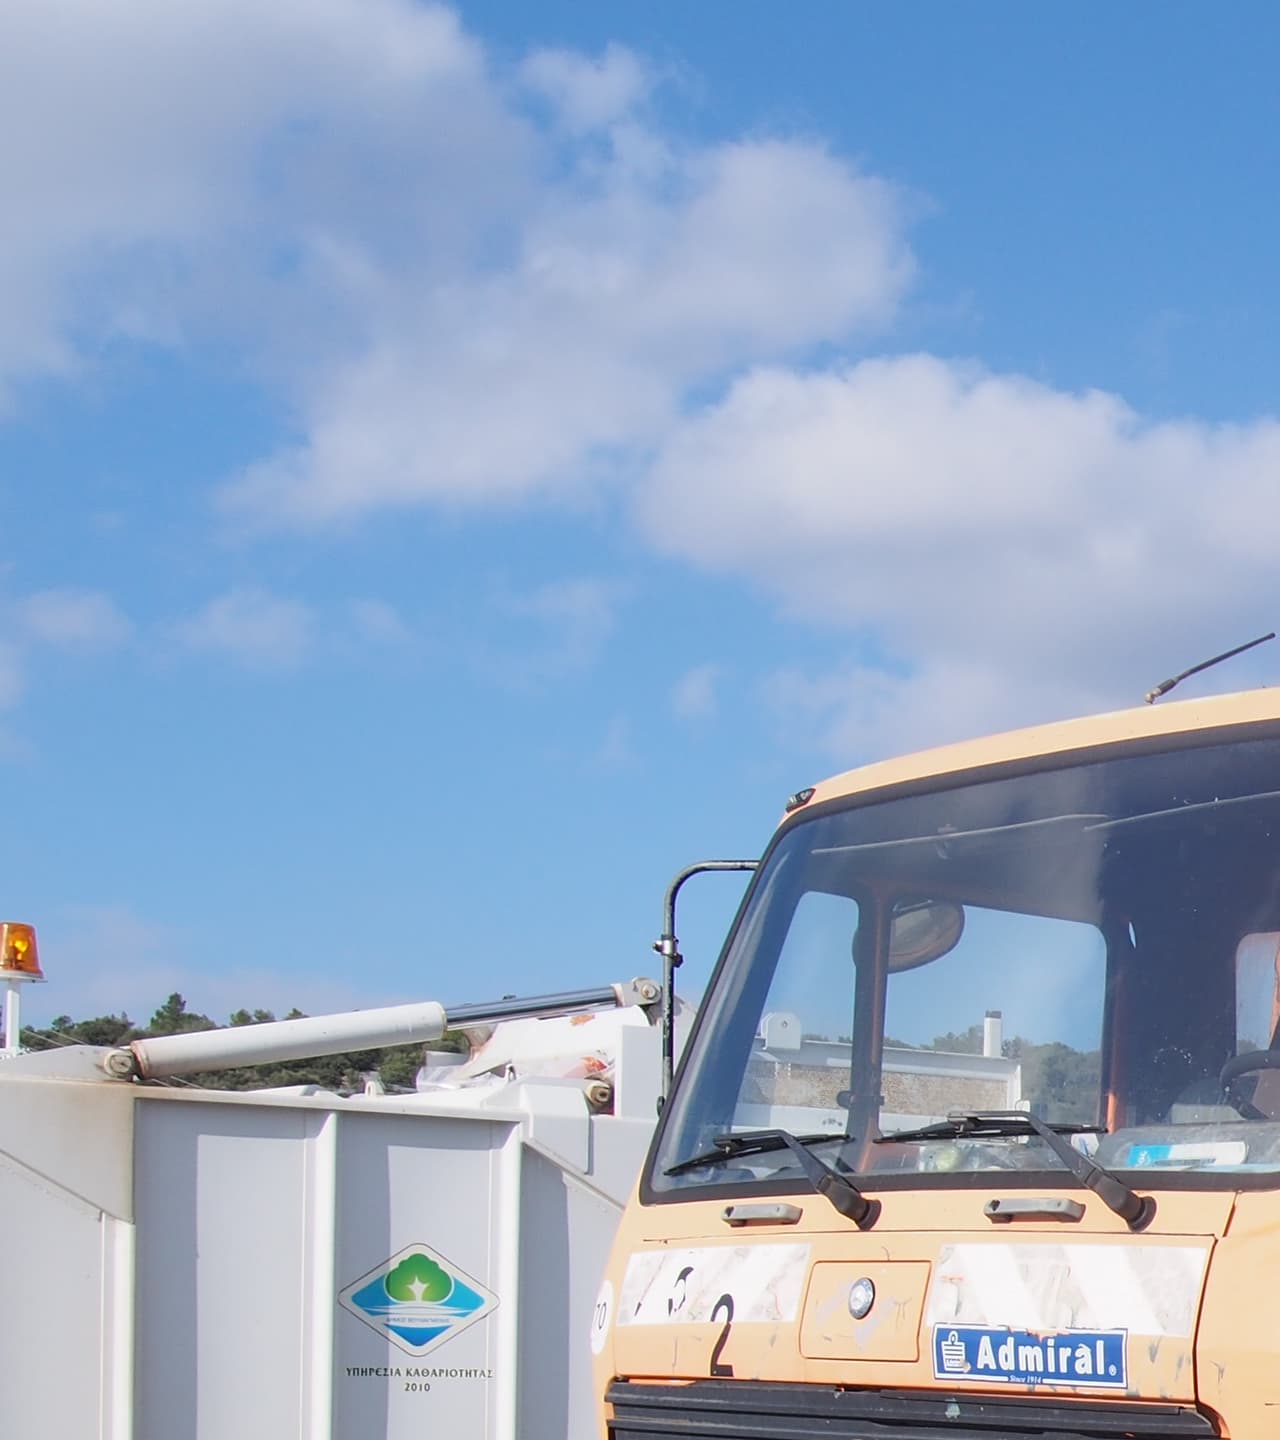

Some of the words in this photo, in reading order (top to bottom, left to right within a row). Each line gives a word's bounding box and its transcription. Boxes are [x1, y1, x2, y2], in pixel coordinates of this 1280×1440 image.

[976, 1335, 1105, 1376] Admiral
[346, 1367, 401, 1377] ΥΠΗΡΕΣΙΑ
[406, 1367, 493, 1378] ΚΑΘΑΡΙΟΤΗΤΑΣ
[404, 1383, 431, 1392] 2010
